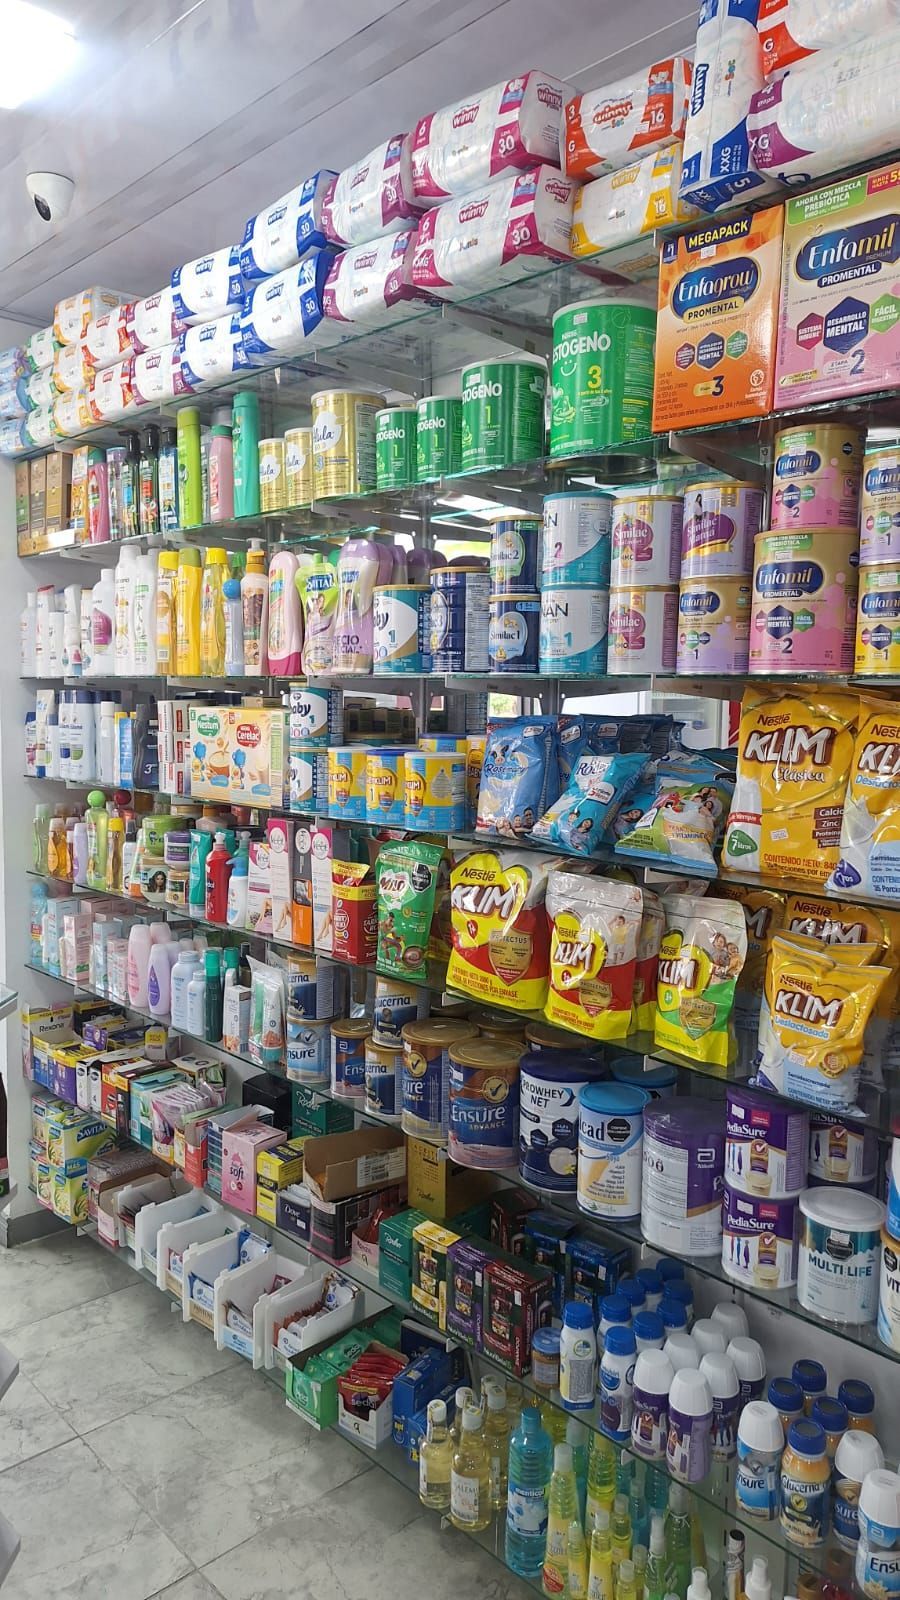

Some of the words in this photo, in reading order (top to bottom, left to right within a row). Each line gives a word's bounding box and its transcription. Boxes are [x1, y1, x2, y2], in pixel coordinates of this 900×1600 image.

[453, 106, 478, 127] winny
[650, 109, 665, 124] 16
[498, 135, 516, 154] 30
[819, 188, 834, 200] CON
[835, 180, 862, 195] MEZCLA
[459, 203, 488, 223] winny
[511, 227, 531, 246] 30
[688, 218, 749, 249] MEGAPACK
[808, 222, 897, 270] Enfamil
[821, 263, 878, 287] PROMENTAL
[678, 269, 754, 303] Enfagrow
[687, 302, 740, 321] PROMENTAL
[827, 311, 867, 327] DESARROLLO
[874, 303, 897, 317] FÁCIL
[826, 320, 865, 338] MENTAL
[850, 349, 866, 377] 2
[587, 365, 601, 389] 3
[711, 375, 725, 397] 3
[792, 506, 800, 518] 2
[554, 541, 563, 559] 2
[759, 567, 813, 585] Enfamil
[388, 629, 396, 644] 1
[782, 637, 793, 654] 2
[757, 712, 791, 727] Nestlé
[744, 727, 833, 766] KLIM
[773, 767, 825, 784] Clásica
[763, 853, 801, 867] CONTENIDO
[460, 867, 497, 882] Nestlé
[451, 883, 519, 918] KLIM
[793, 900, 833, 917] Nestlé
[554, 941, 595, 971] KLIM
[658, 959, 696, 988] KLIM
[780, 974, 813, 993] Nestlé
[775, 990, 843, 1027] KLIM
[522, 1079, 564, 1100] PROWHEY
[530, 1095, 551, 1108] NET
[452, 1104, 507, 1125] Ensure
[284, 1203, 300, 1218] Dove
[727, 1213, 775, 1231] PediaSure
[781, 1475, 820, 1492] Glucerna
